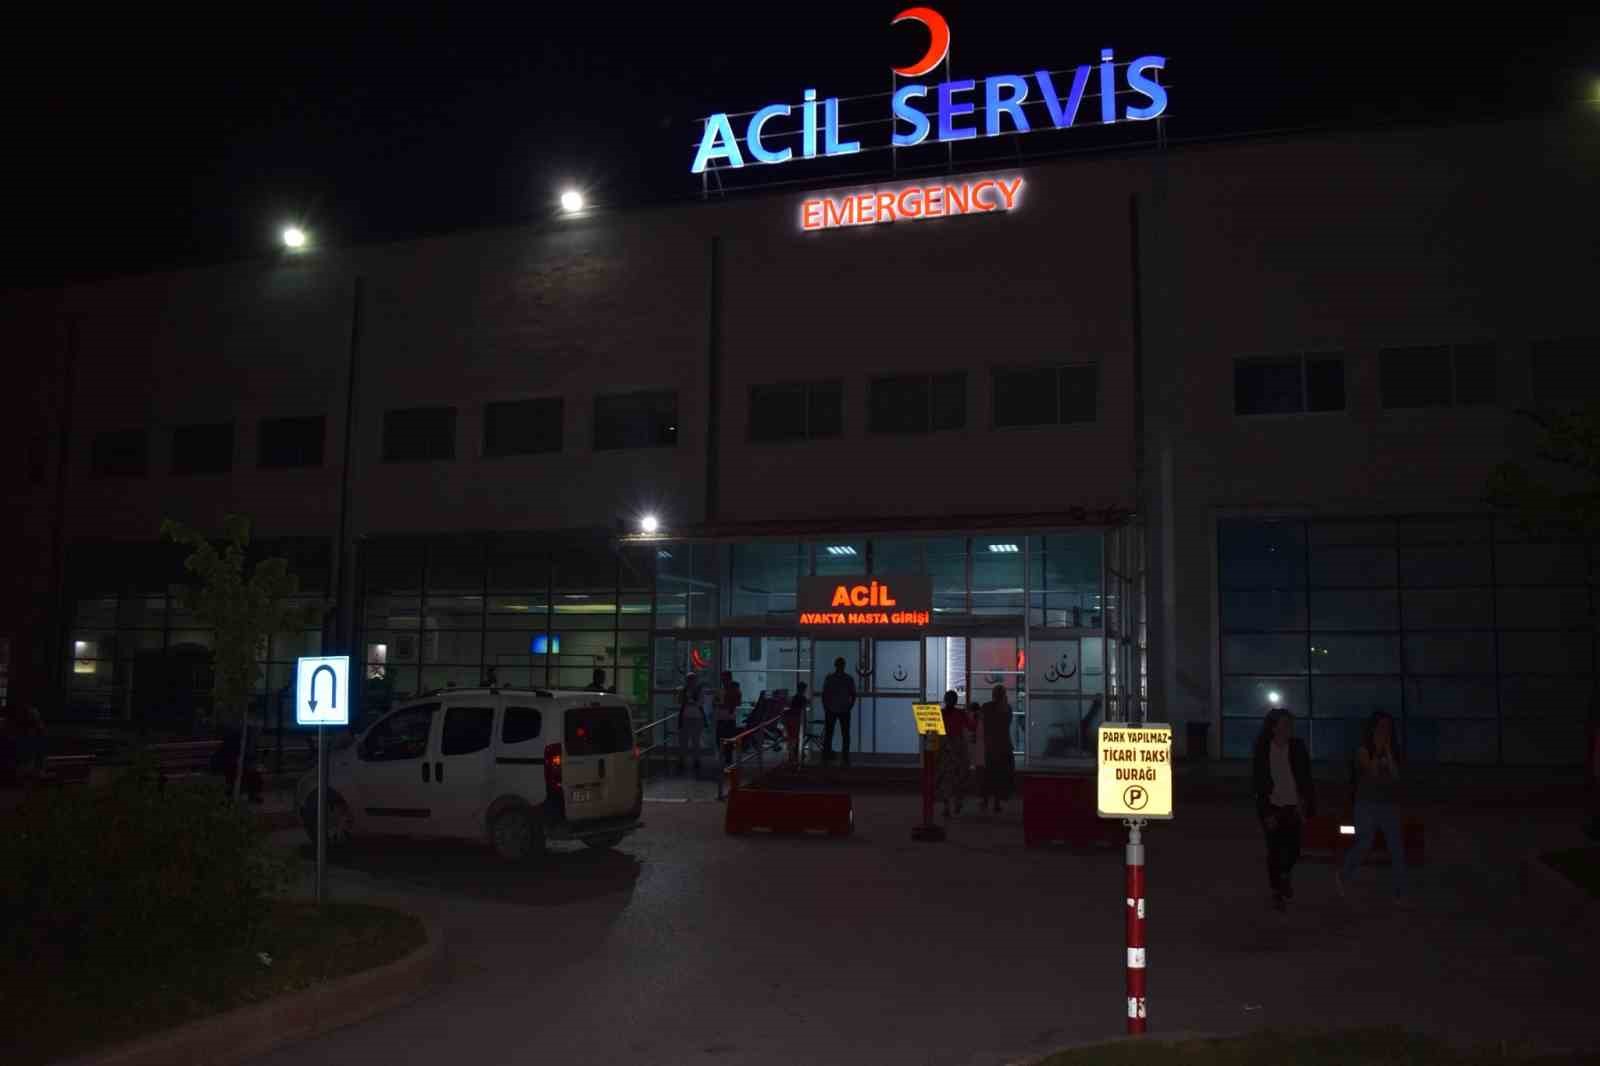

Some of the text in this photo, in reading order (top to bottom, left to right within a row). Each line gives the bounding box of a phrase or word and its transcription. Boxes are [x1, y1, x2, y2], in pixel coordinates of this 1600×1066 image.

[691, 48, 1168, 173] ACİL SERVİS
[802, 177, 1023, 231] EMERGENCY
[832, 580, 896, 607] ACİL
[800, 611, 929, 626] AYAKTA HASTA GİRİŞİ
[1103, 732, 1125, 743] PARK
[1103, 747, 1137, 762] TİCARİ
[1116, 766, 1156, 781] DURAĞI
